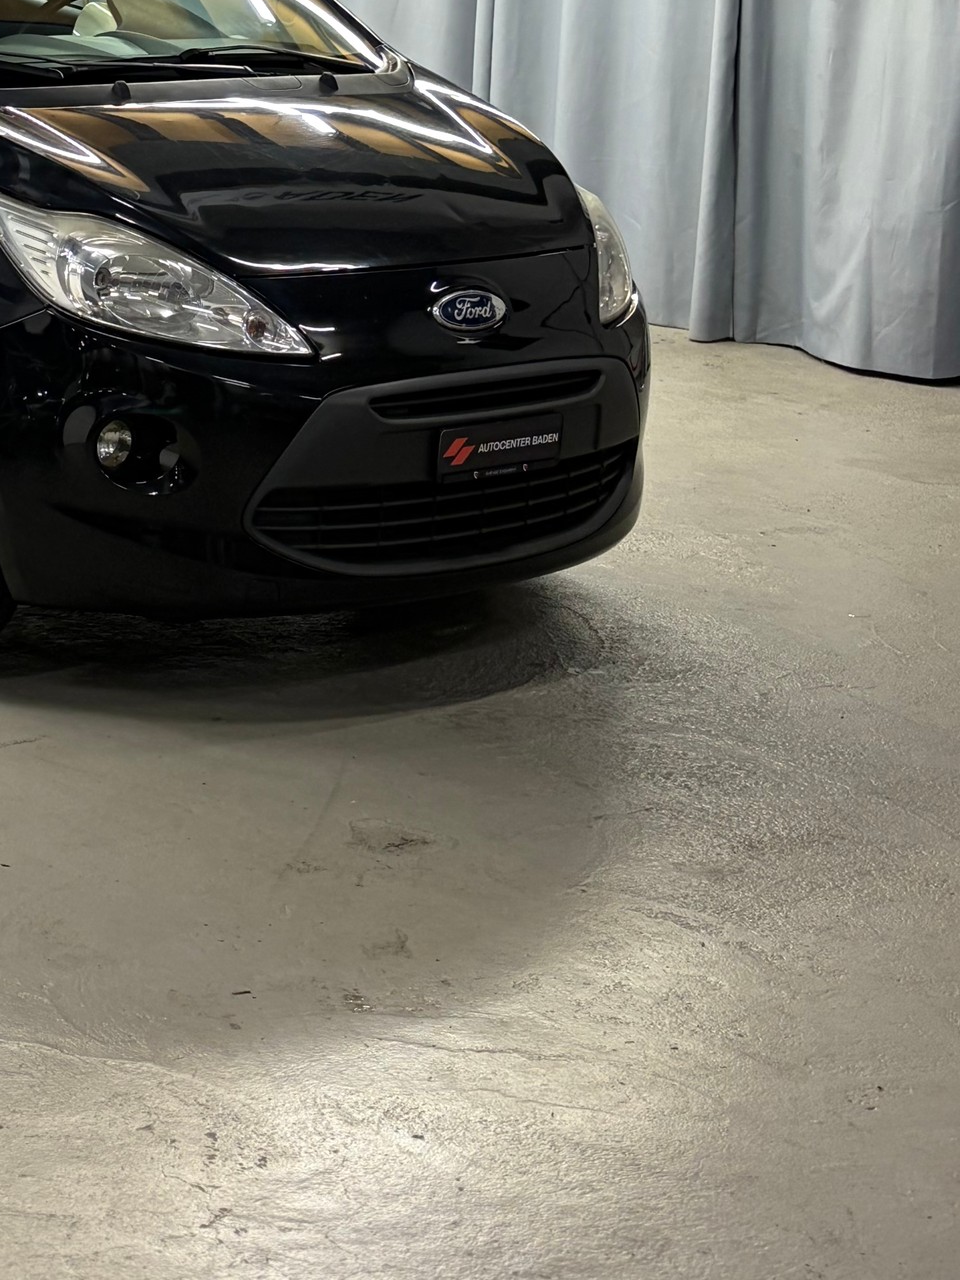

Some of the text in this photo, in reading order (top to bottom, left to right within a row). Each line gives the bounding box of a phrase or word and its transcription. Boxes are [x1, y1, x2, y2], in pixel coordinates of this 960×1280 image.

[453, 297, 493, 321] Ford
[477, 432, 559, 453] AUTOCENTER BADEN
